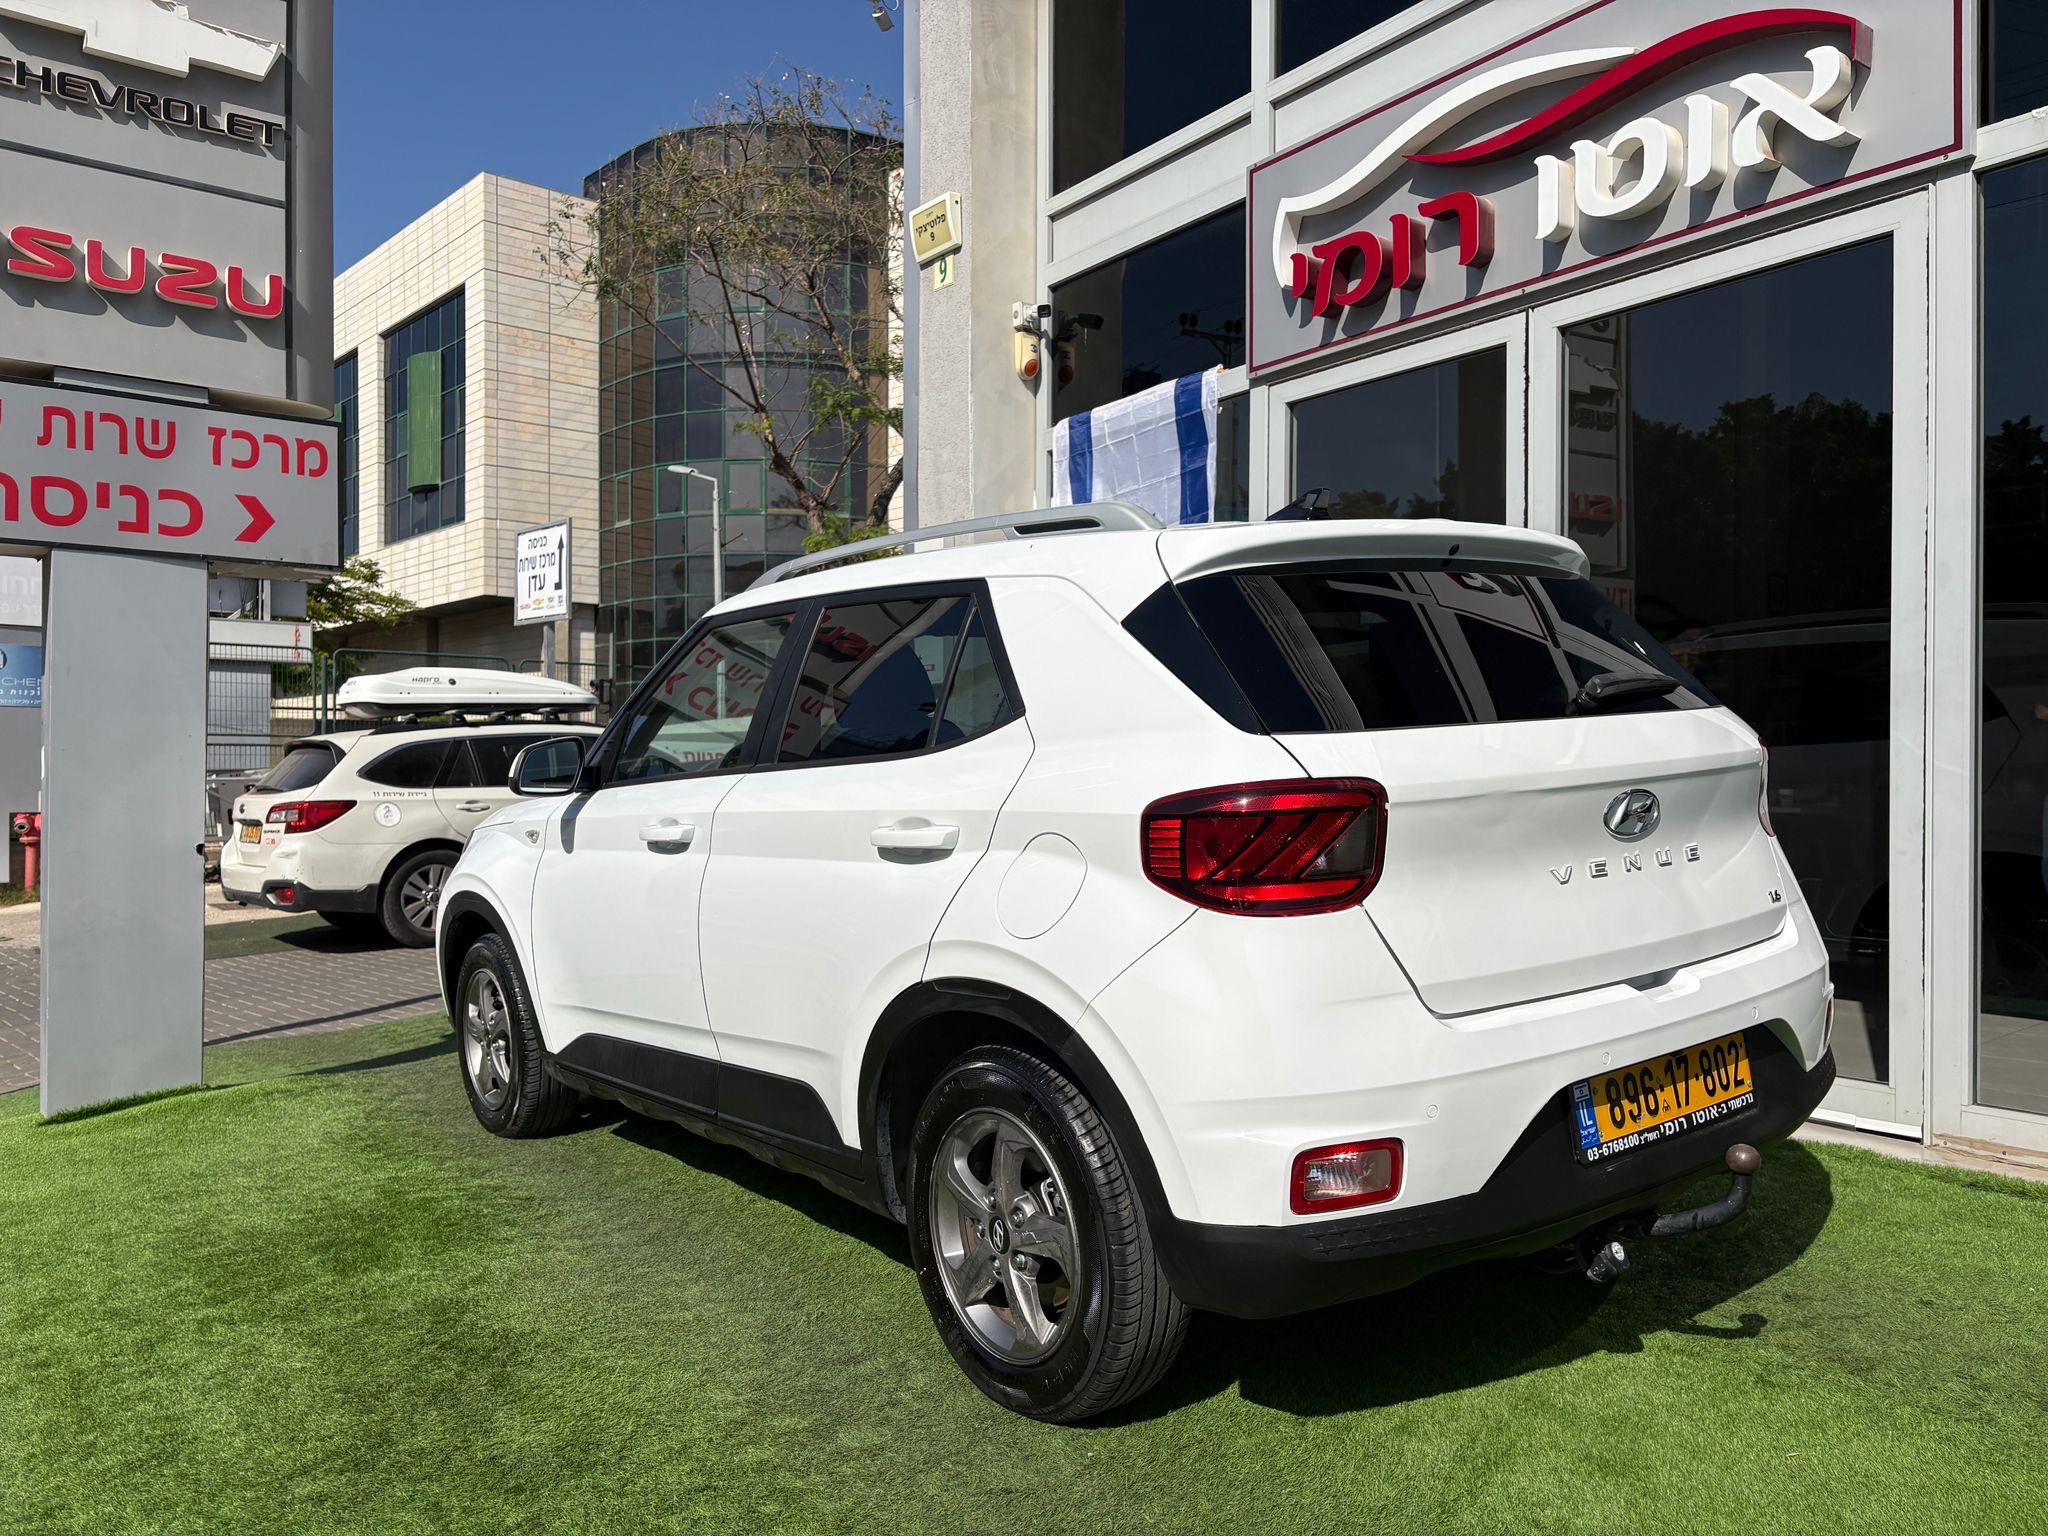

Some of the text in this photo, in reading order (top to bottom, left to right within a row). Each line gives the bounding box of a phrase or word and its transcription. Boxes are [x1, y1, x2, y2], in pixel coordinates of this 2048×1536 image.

[1290, 46, 1862, 319] אוטו רומי
[929, 231, 936, 242] 9
[36, 405, 329, 478] מרכז שרות
[528, 535, 548, 550] כניסה
[518, 552, 556, 573] מרכז שירות
[528, 573, 546, 598] עדן
[1550, 843, 1701, 885] VENUE
[1579, 1101, 1594, 1127] IL
[1660, 1117, 1687, 1136] רומי
[1587, 1133, 1640, 1161] 03-6768100
